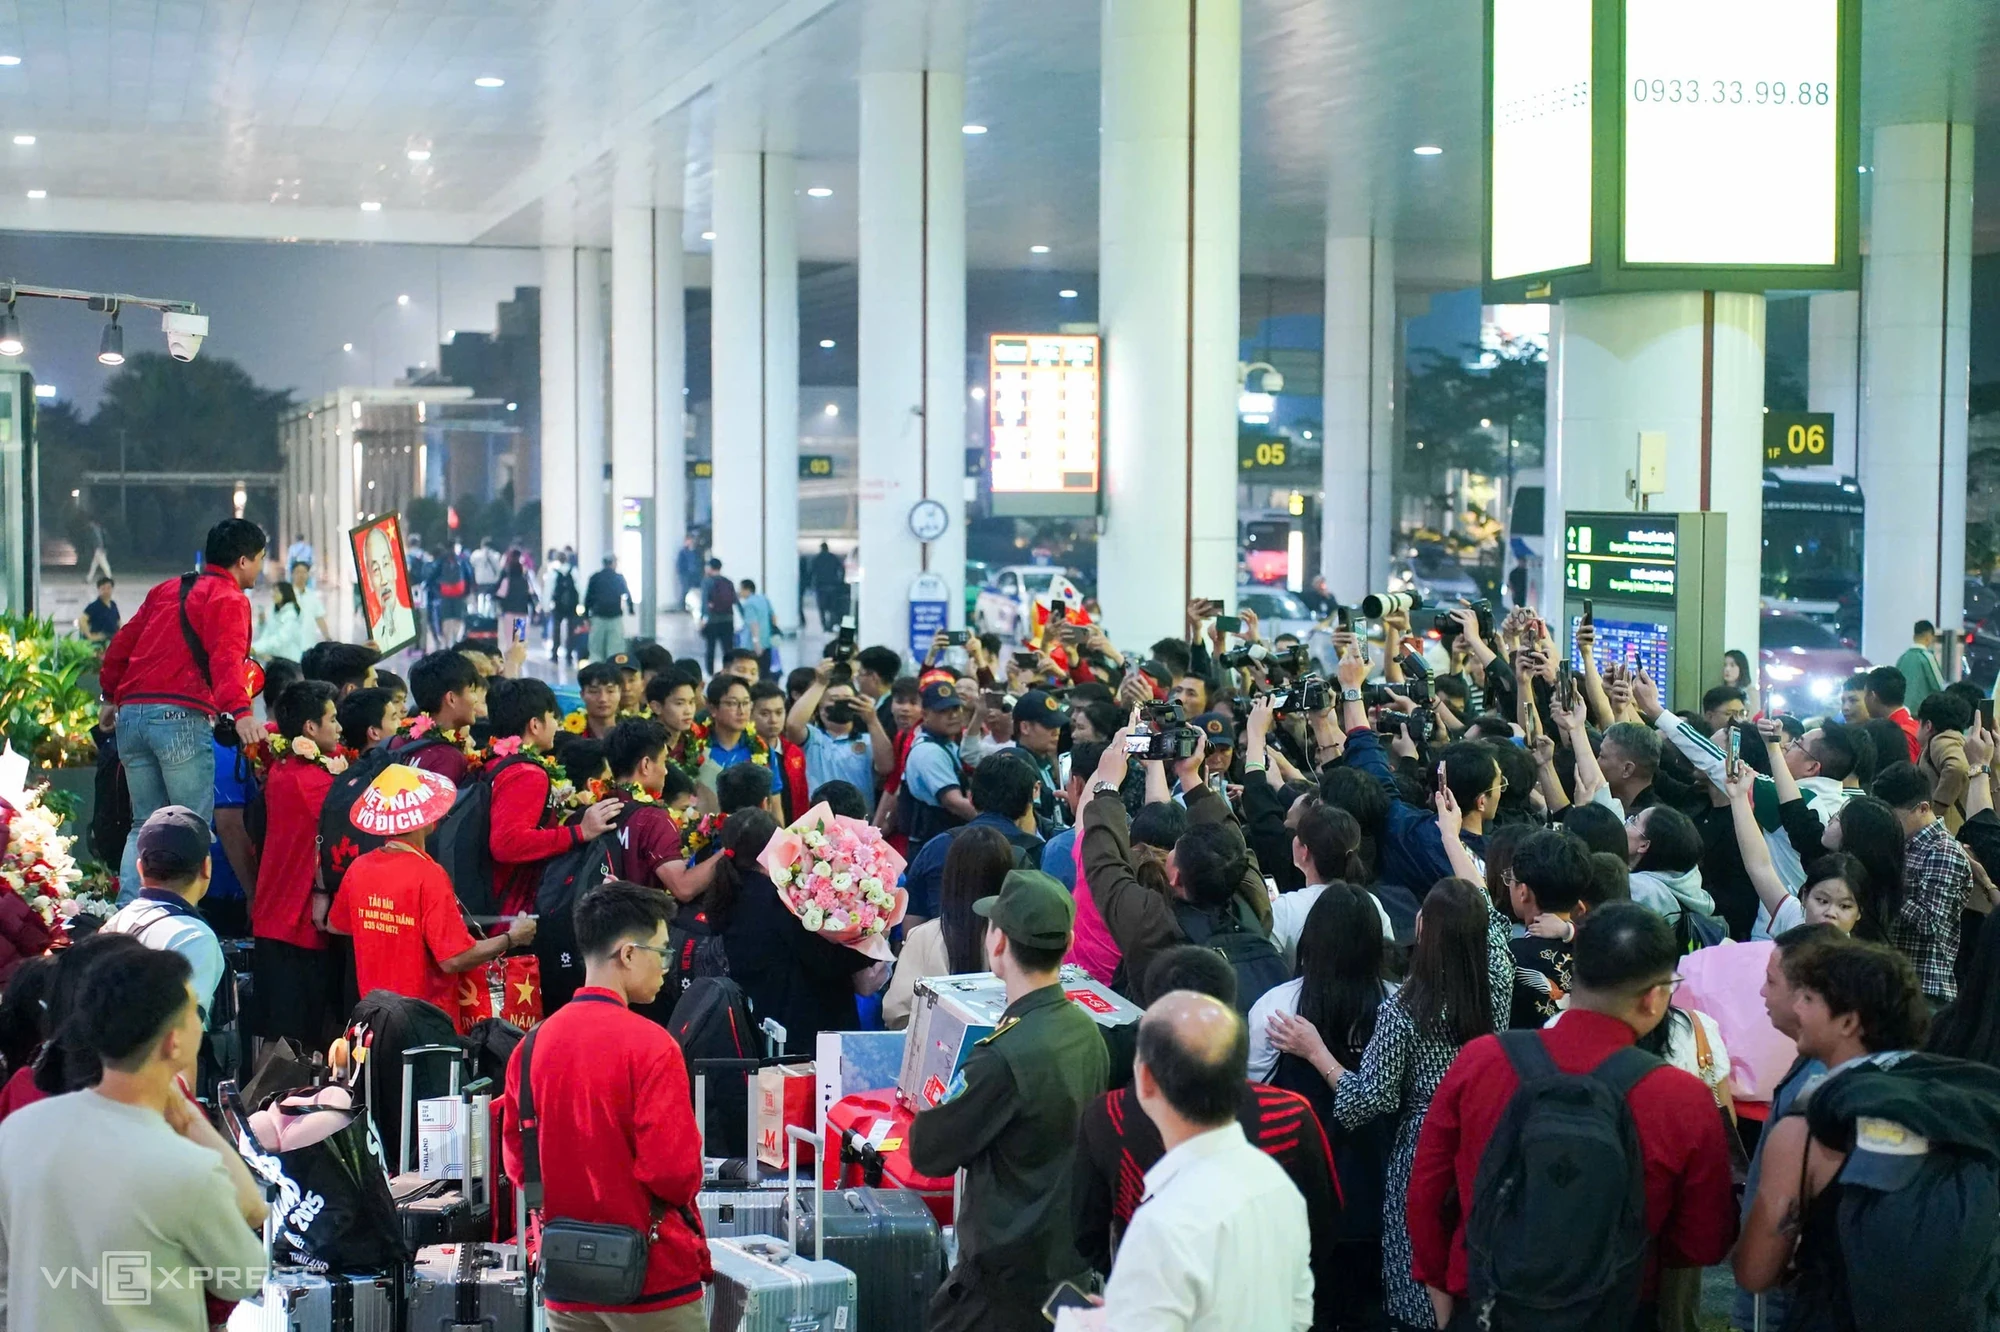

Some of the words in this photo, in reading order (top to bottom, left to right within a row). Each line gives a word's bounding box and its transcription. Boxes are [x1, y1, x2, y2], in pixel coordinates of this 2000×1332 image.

[1634, 78, 1829, 106] 0933.33.99.88
[1256, 443, 1286, 466] 05
[1768, 447, 1781, 459] 1F
[1787, 424, 1825, 454] 06
[389, 783, 435, 812] NAM
[356, 806, 375, 829] VÔ
[375, 808, 425, 834] ĐỊCH
[509, 1011, 536, 1028] NĂM
[289, 1189, 325, 1232] 2025
[288, 1251, 329, 1271] THAILAND
